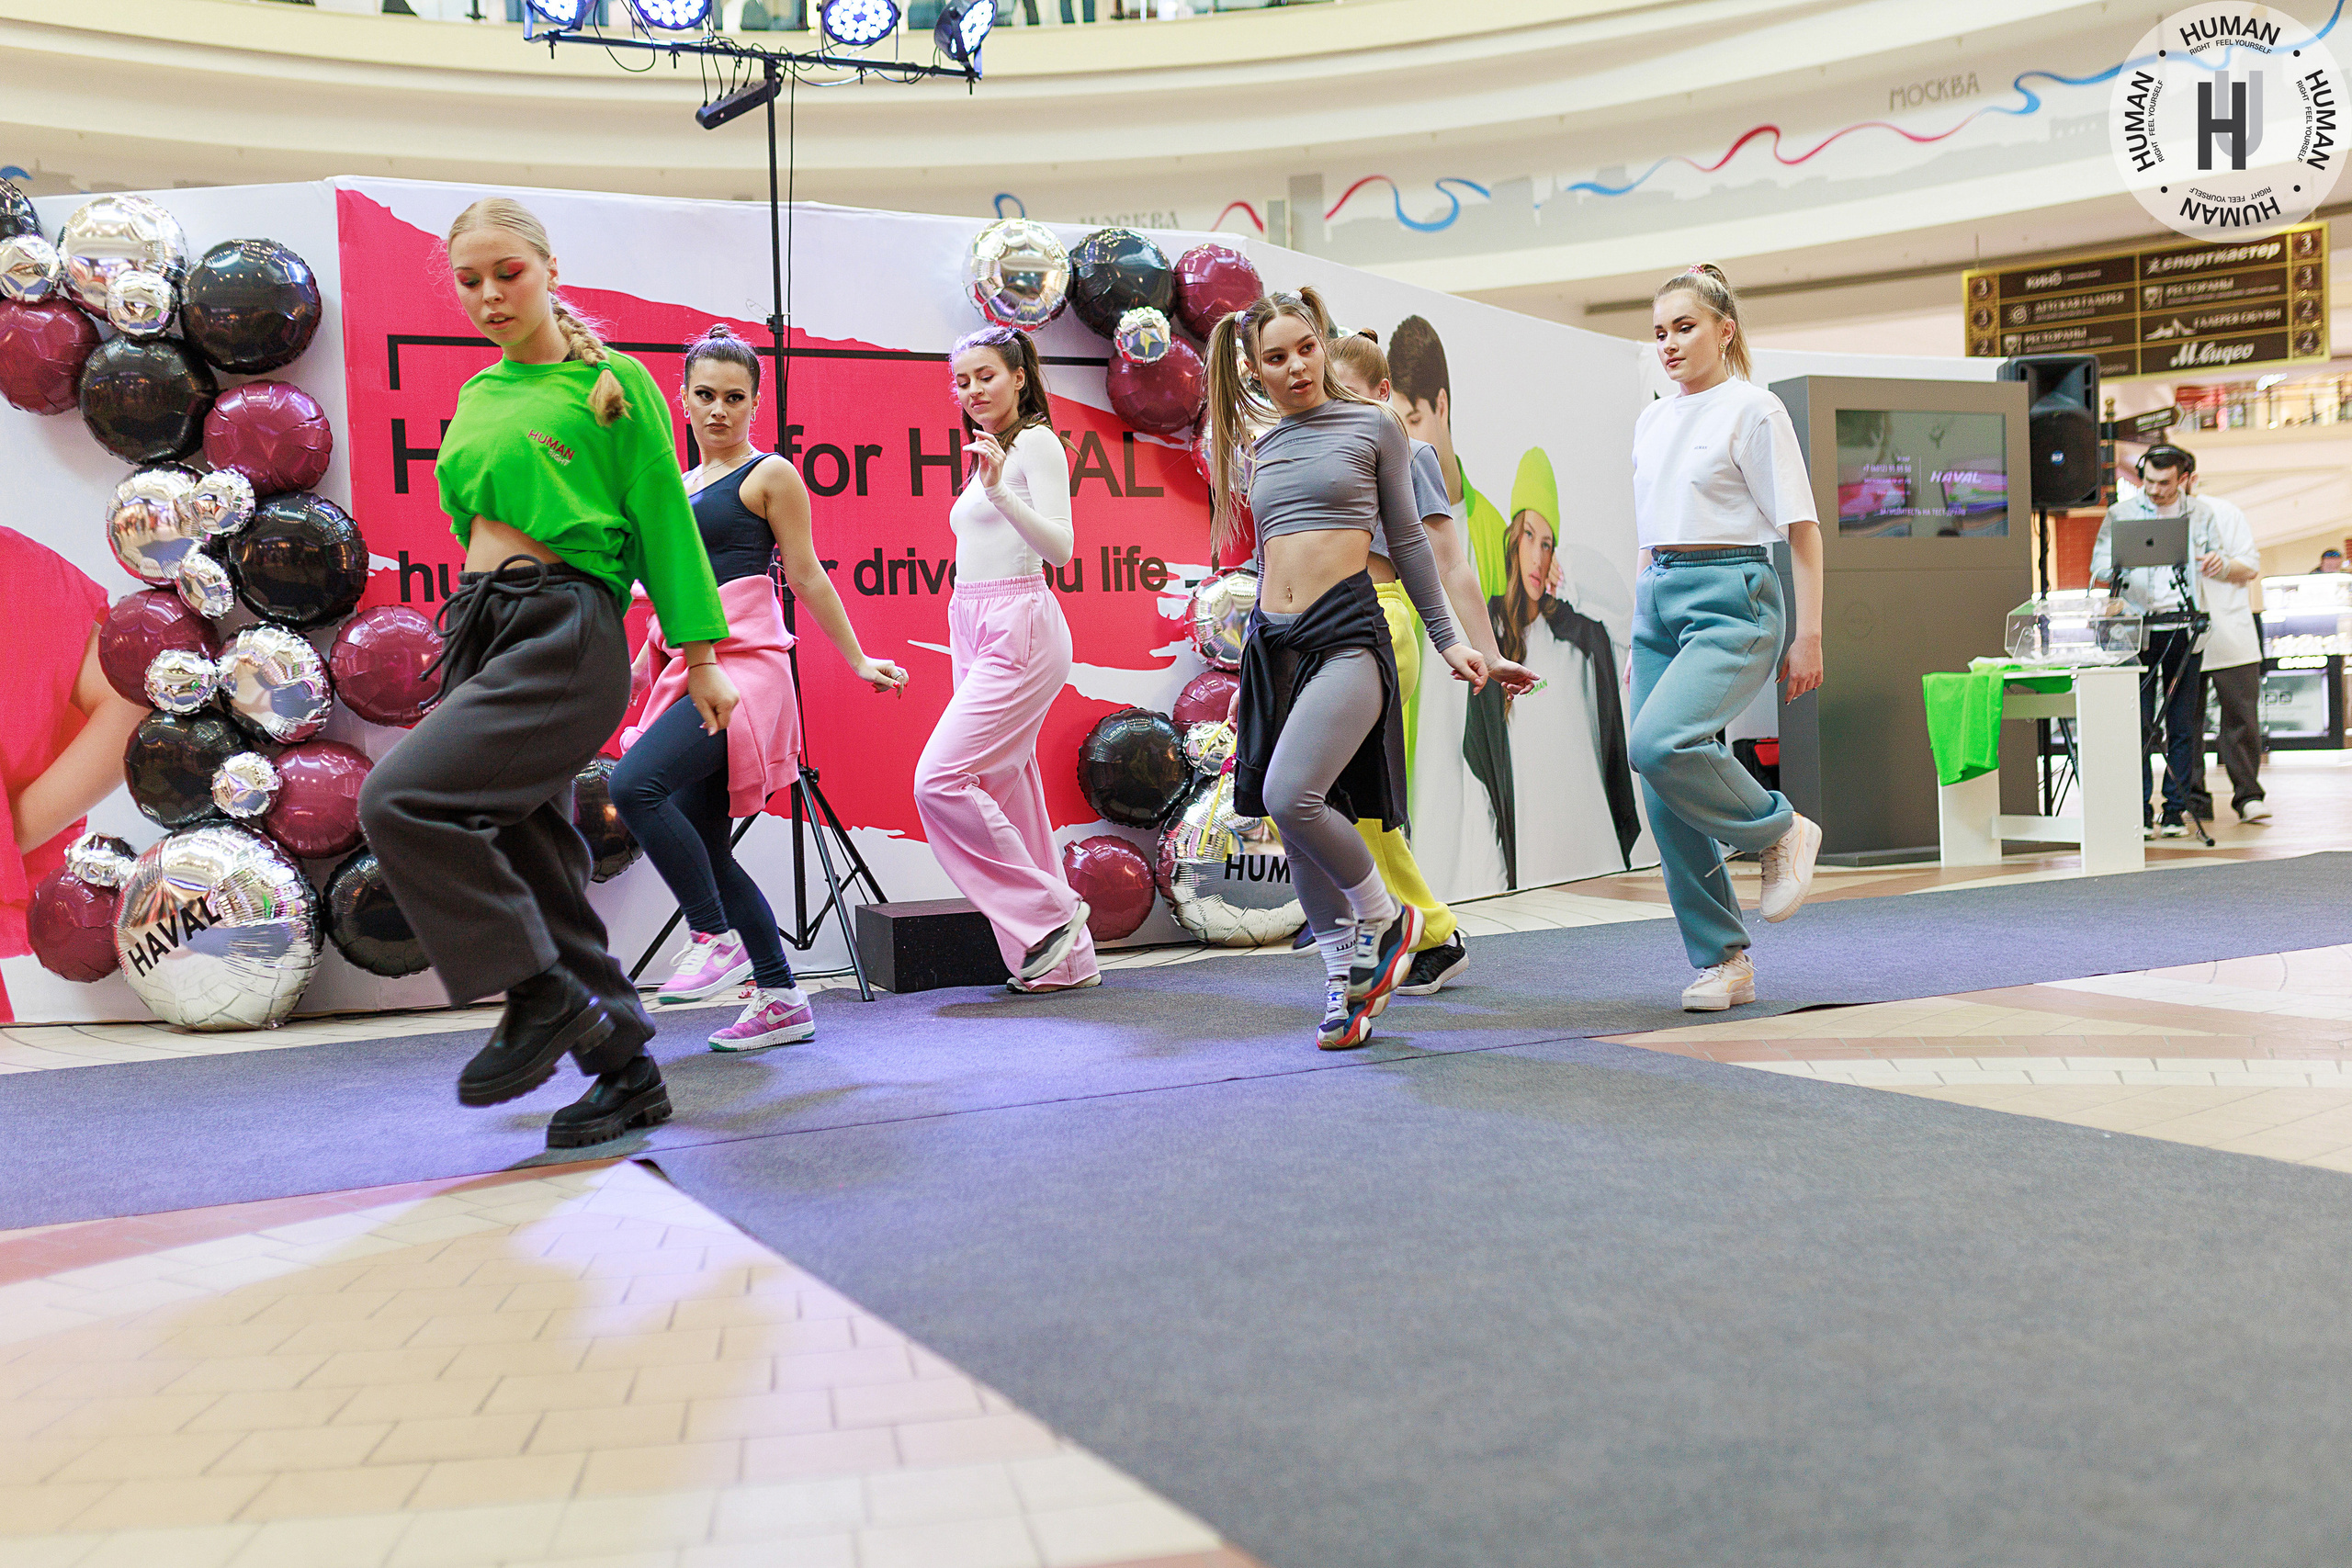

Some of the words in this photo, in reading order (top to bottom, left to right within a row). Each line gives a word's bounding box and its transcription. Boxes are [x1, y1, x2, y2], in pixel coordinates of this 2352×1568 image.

[1889, 71, 1982, 112] МОСКВА
[2301, 232, 2312, 254] 3
[1978, 277, 1988, 297] 3
[2301, 265, 2313, 287] 3
[2301, 299, 2312, 318] 2
[1978, 338, 1989, 355] 2
[2301, 331, 2313, 349] 2
[527, 429, 575, 460] HUMAN
[548, 449, 571, 466] RIGHT
[775, 424, 883, 497] for
[1930, 470, 1982, 483] HAVAL
[1101, 546, 1168, 592] life
[1225, 853, 1291, 884] HUM
[127, 896, 223, 978] HAVAL
